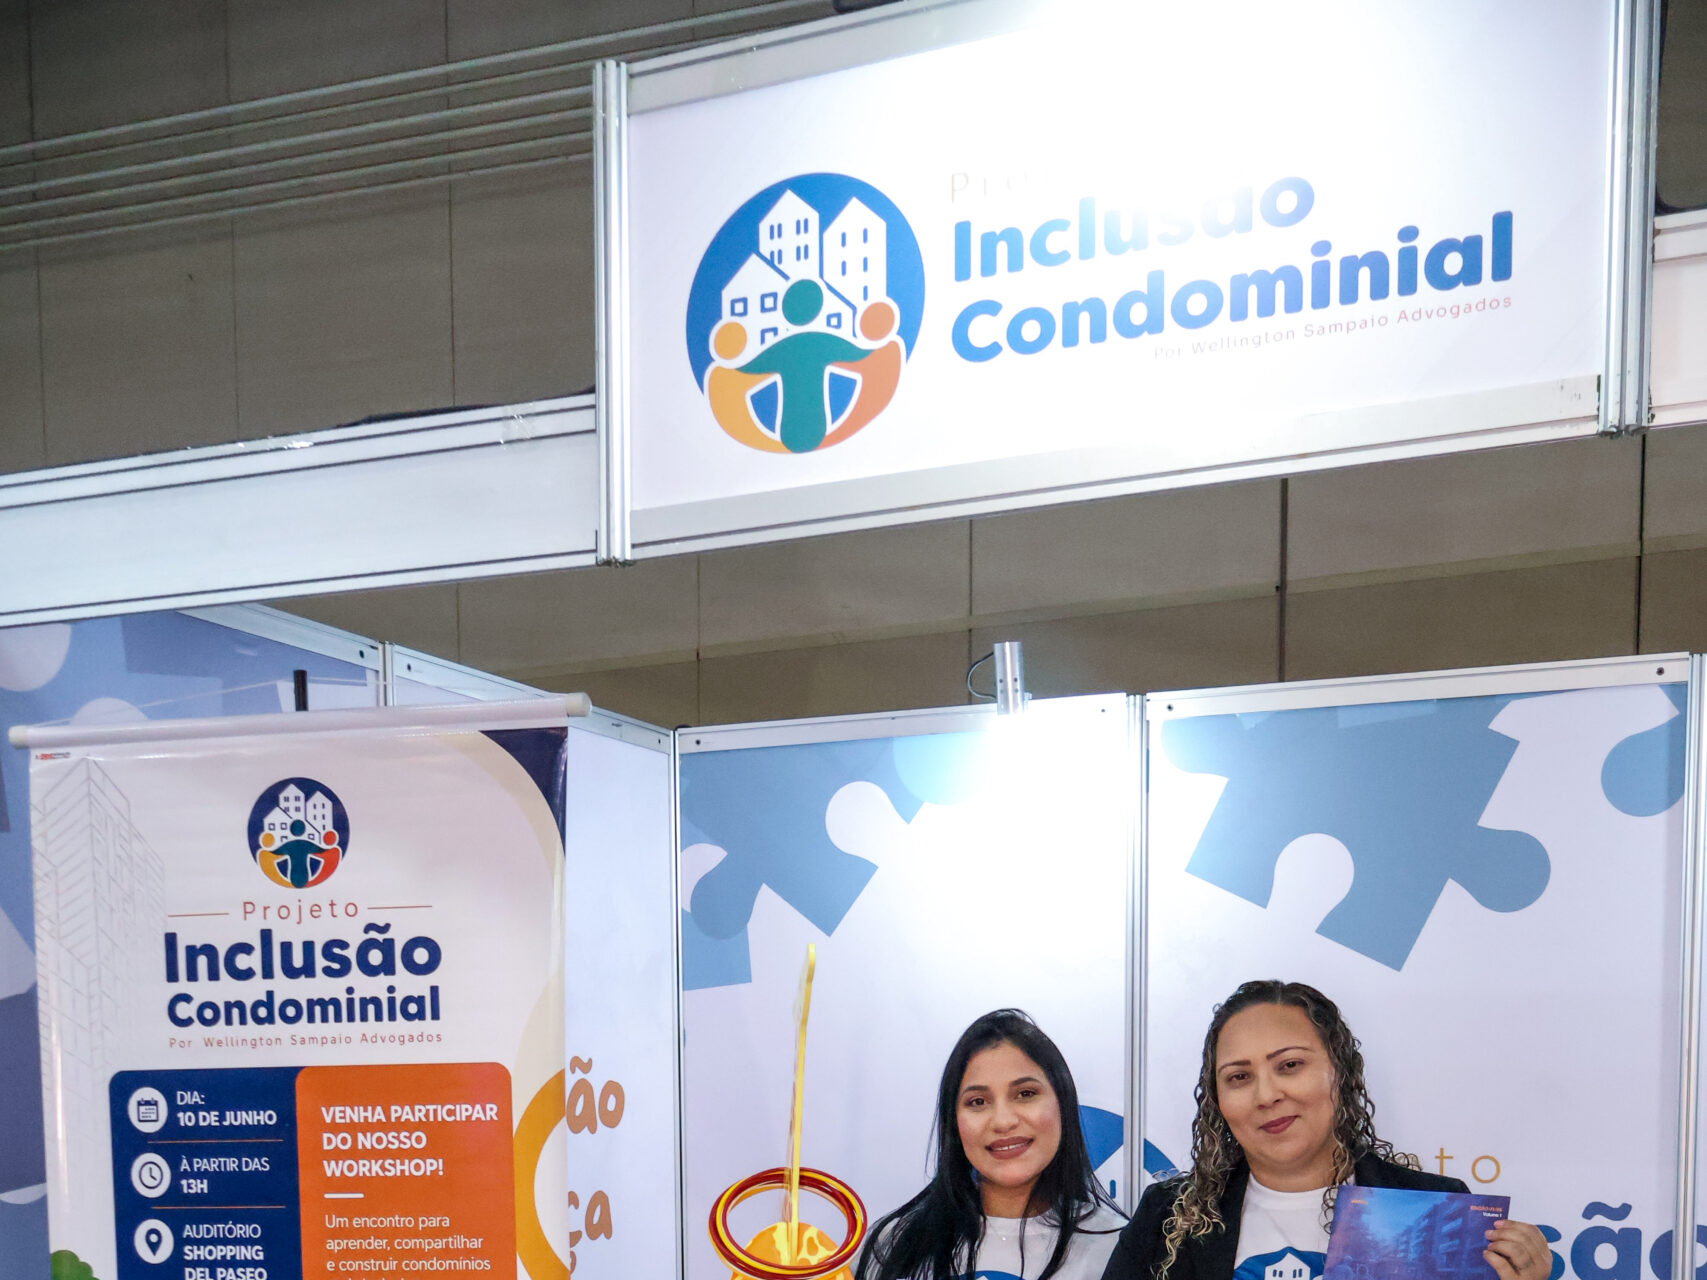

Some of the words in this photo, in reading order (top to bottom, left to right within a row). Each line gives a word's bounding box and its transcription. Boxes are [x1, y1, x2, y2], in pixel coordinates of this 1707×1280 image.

[951, 210, 1514, 363] Condominial
[1191, 328, 1295, 355] Wellington
[1304, 314, 1389, 338] Sampaio
[1397, 296, 1513, 325] Advogados
[243, 899, 359, 924] Projeto
[164, 922, 442, 983] Inclusão
[167, 985, 440, 1027] Condominial
[169, 1036, 192, 1048] Por
[203, 1034, 282, 1049] Wellington
[290, 1034, 352, 1046] Sampaio
[360, 1032, 442, 1045] Advogados
[176, 1091, 205, 1105] DIA:
[177, 1111, 196, 1126] 10
[198, 1111, 220, 1126] DE
[222, 1110, 277, 1125] JUNHO
[321, 1106, 386, 1123] VENHA
[390, 1104, 498, 1122] PARTICIPAR
[322, 1132, 352, 1150] DO
[357, 1131, 427, 1149] NOSSO
[180, 1155, 191, 1172] À
[193, 1157, 239, 1172] PARTIR
[242, 1157, 270, 1171] DAS
[323, 1159, 444, 1177] WORKSHOP!
[180, 1179, 208, 1193] 13H
[183, 1221, 261, 1238] AUDITÓRIO
[325, 1214, 349, 1228] Um
[352, 1214, 415, 1228] encontro
[418, 1216, 450, 1230] para
[326, 1236, 390, 1252] aprender,
[394, 1235, 484, 1251] compartilhar
[183, 1245, 264, 1260] SHOPPING
[326, 1260, 335, 1271] e
[338, 1257, 398, 1271] construir
[401, 1256, 491, 1270] condomínios
